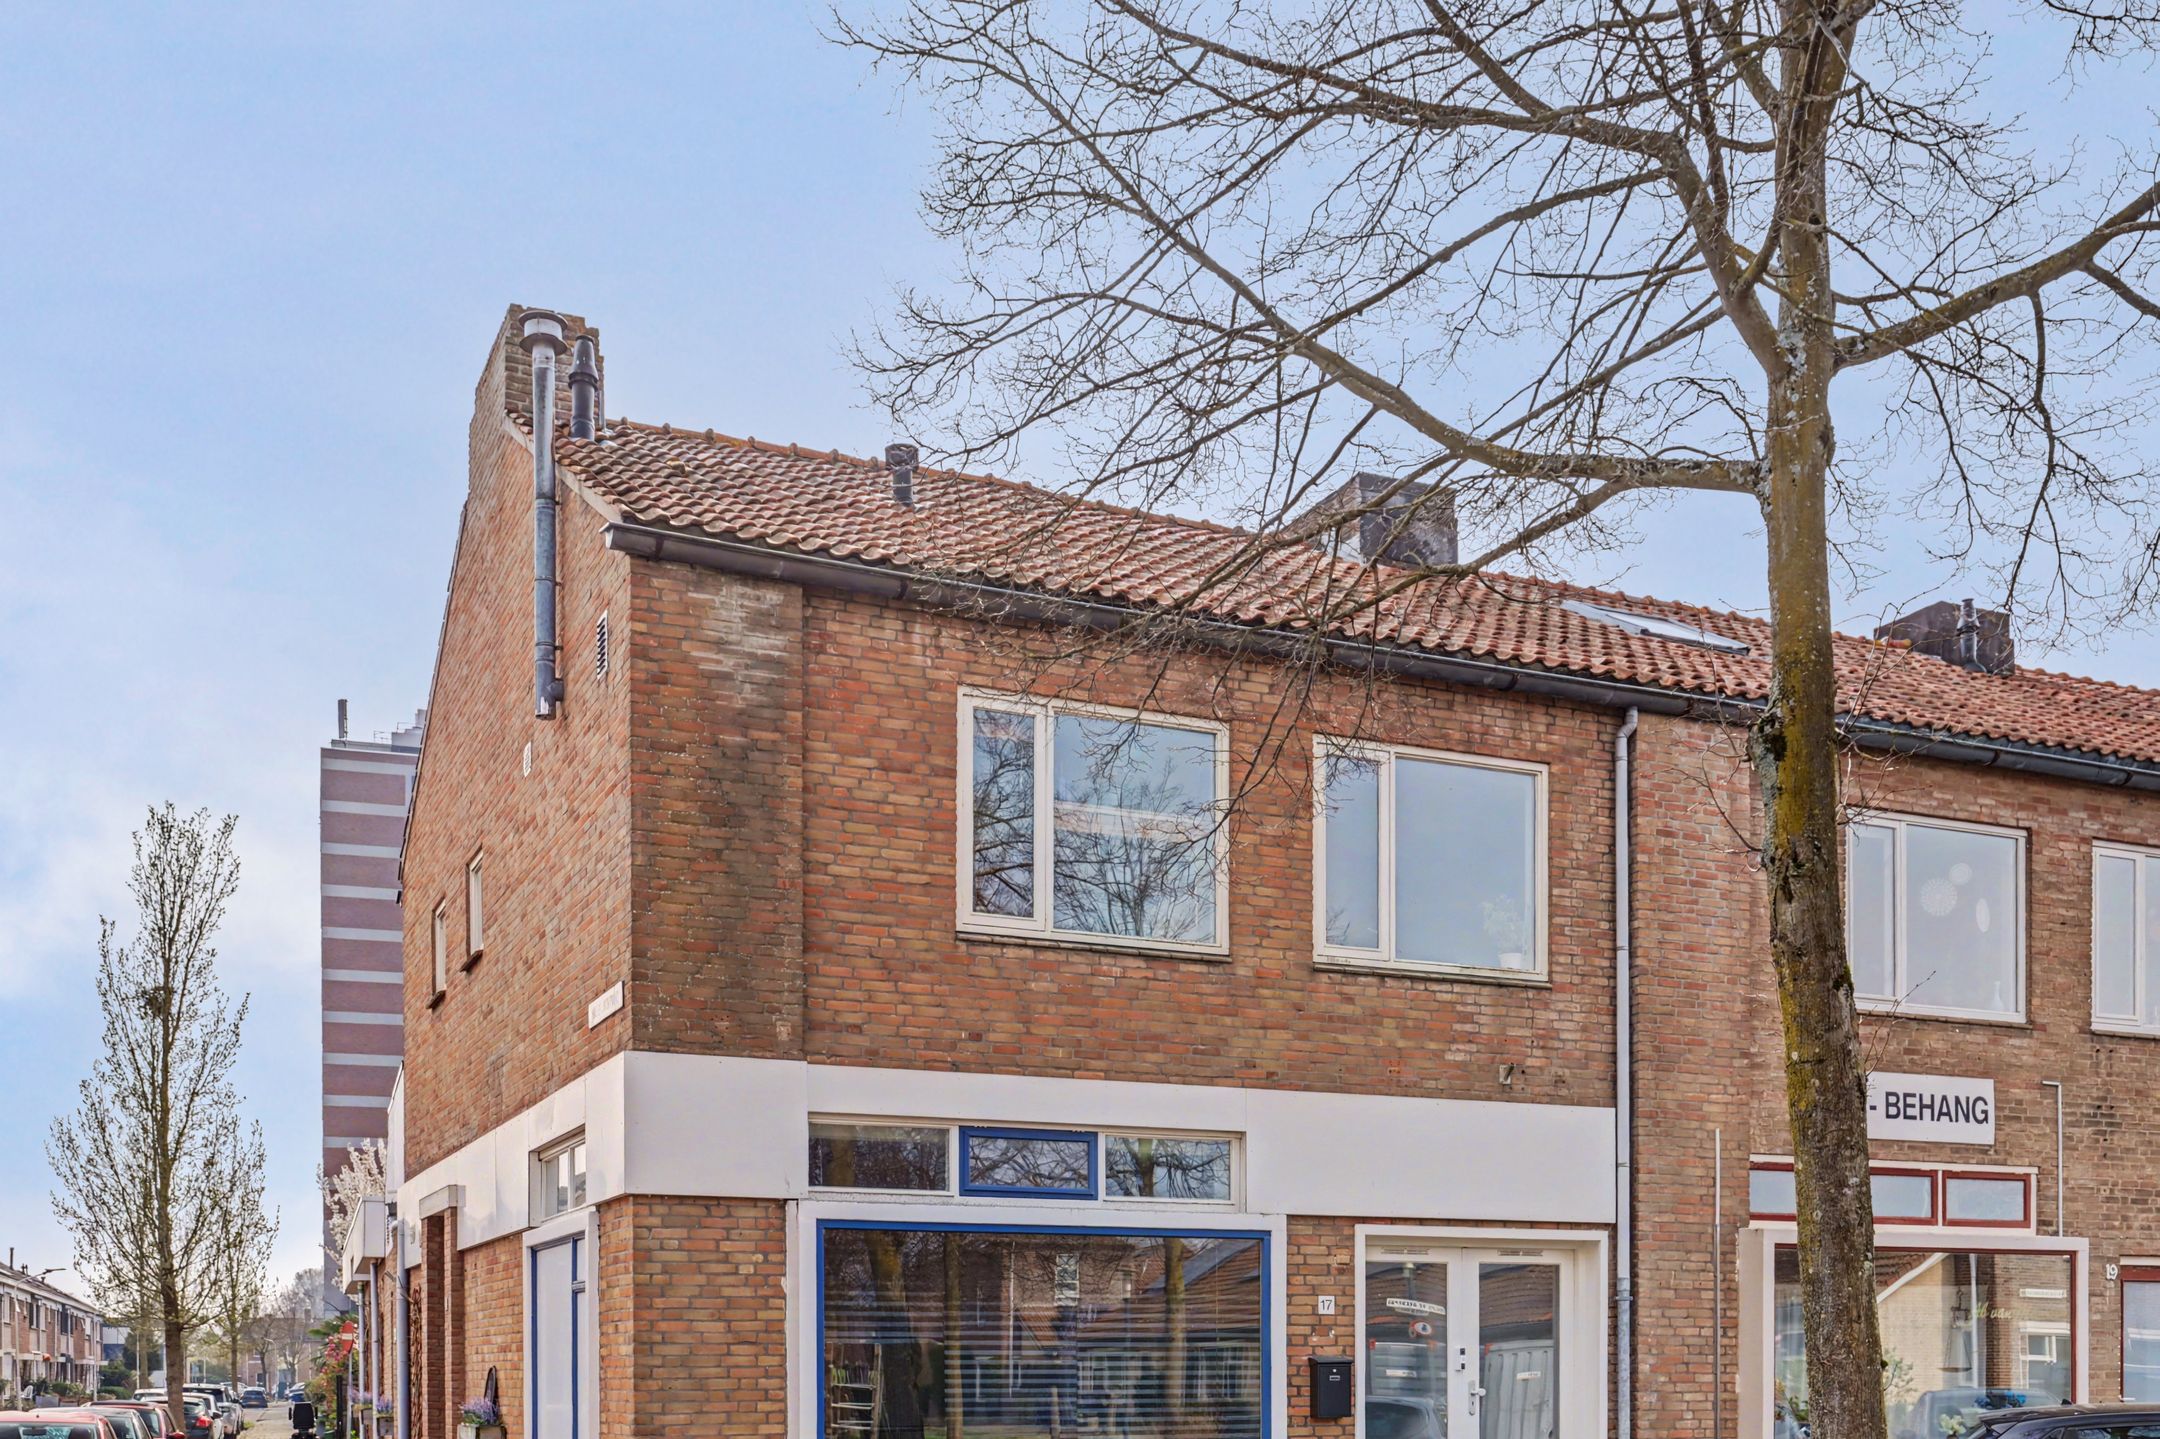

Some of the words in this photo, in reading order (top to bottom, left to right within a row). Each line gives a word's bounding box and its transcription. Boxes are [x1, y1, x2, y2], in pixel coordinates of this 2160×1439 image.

[1885, 1091, 1989, 1125] BEHANG
[2105, 1263, 2119, 1280] 19
[1320, 1299, 1333, 1311] 17
